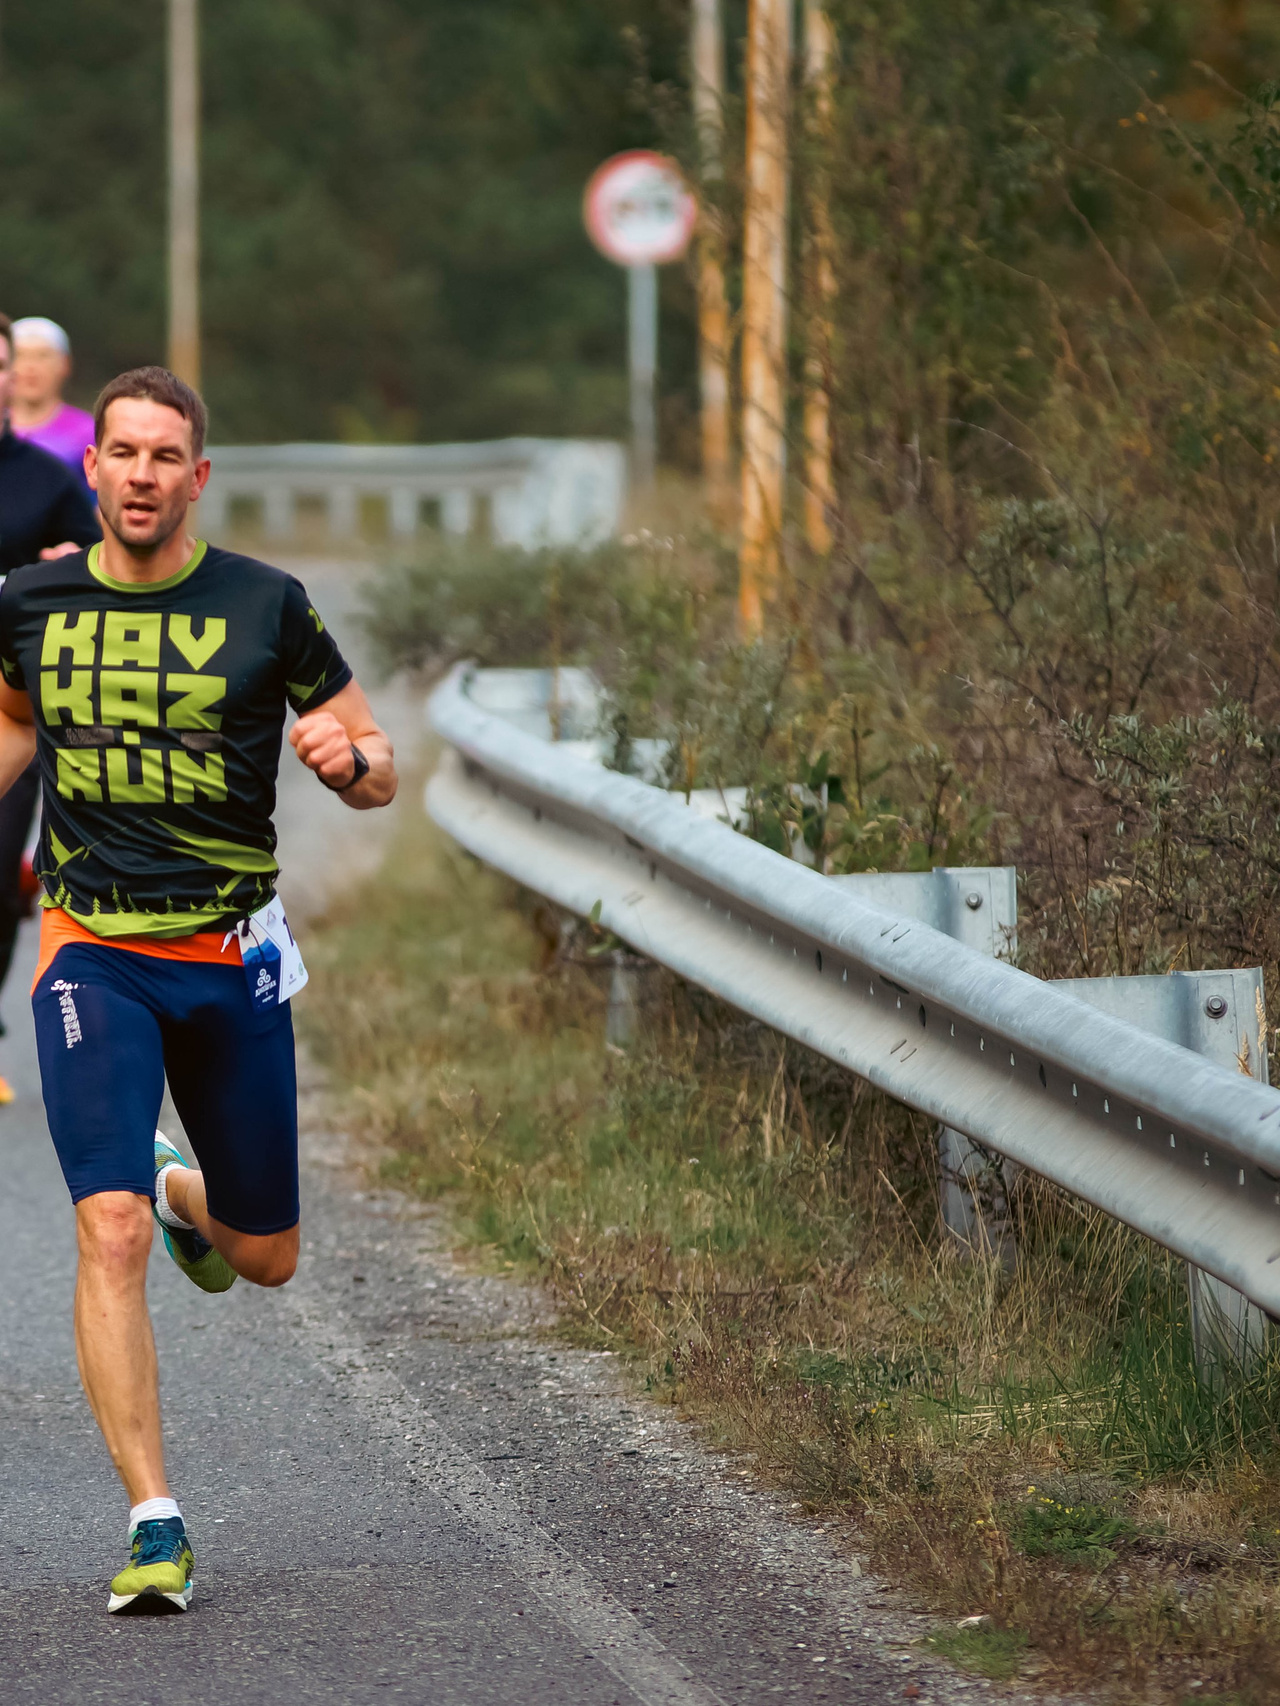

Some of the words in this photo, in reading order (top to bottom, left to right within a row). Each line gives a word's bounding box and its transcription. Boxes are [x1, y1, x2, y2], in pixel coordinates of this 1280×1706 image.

[40, 610, 227, 671] KAV
[40, 670, 227, 732] KAZ
[55, 748, 229, 804] RUN
